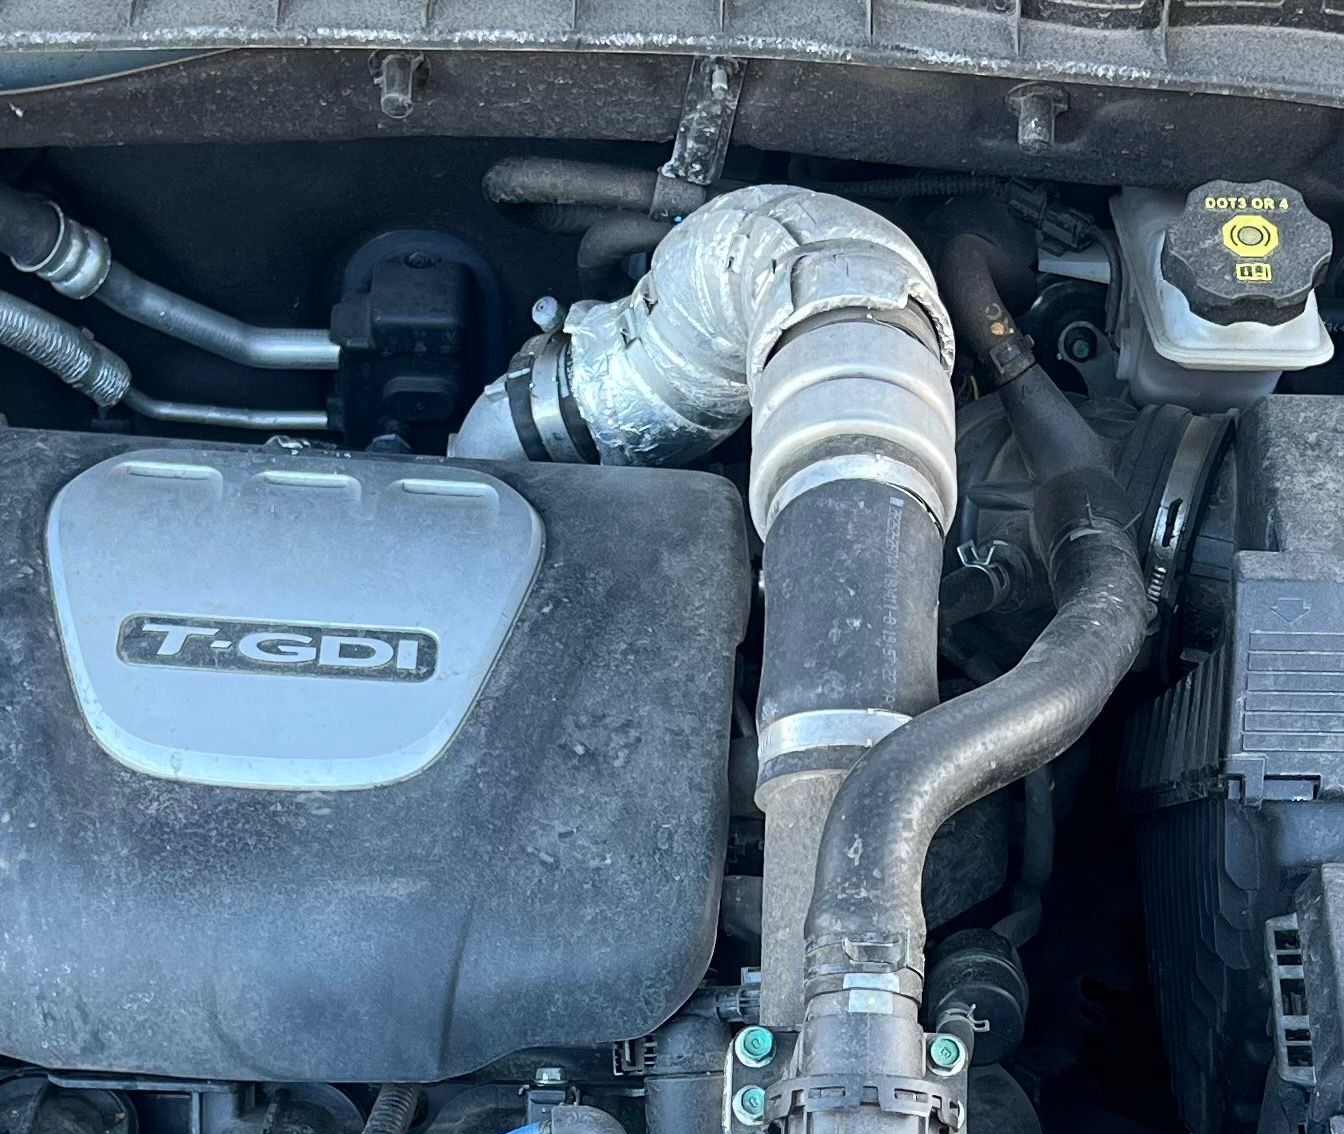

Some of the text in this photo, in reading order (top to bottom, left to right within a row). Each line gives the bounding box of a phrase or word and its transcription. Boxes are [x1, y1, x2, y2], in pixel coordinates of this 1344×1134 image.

[1205, 197, 1289, 210] DOT3 OR 4
[142, 622, 419, 670] T-GDI
